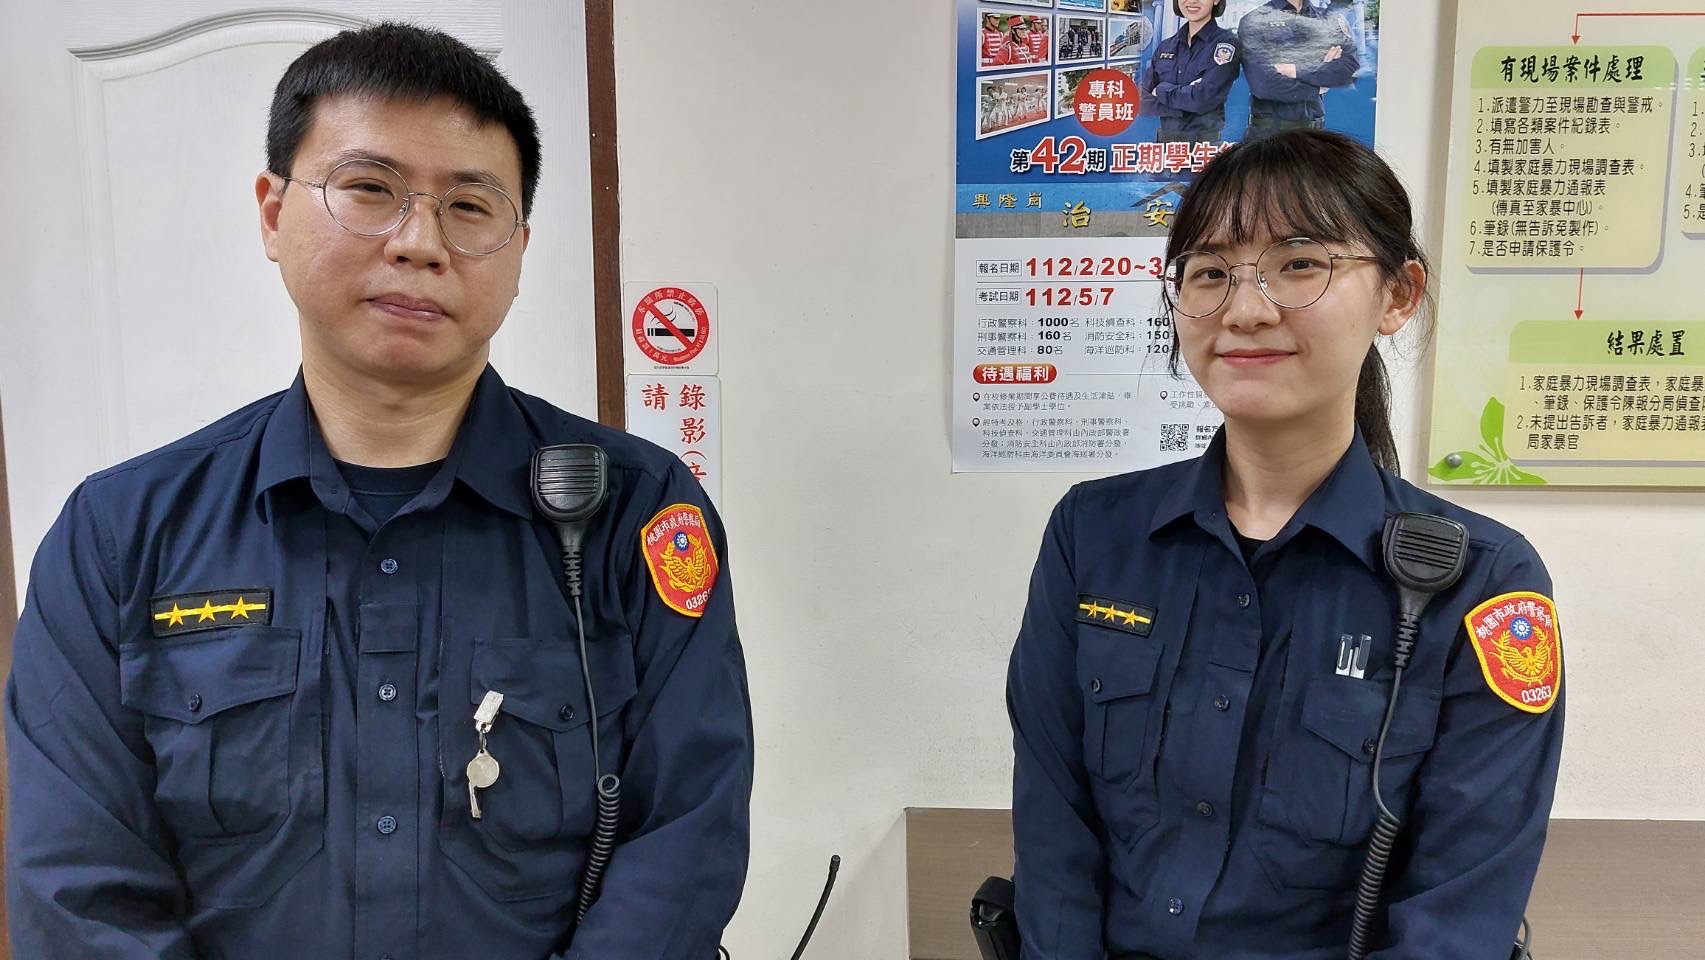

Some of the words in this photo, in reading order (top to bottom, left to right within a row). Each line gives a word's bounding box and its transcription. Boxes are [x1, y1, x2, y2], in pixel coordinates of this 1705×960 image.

[1499, 54, 1645, 84] 有現場案件處理
[1087, 79, 1125, 99] 專科
[1078, 102, 1134, 122] 警員班
[1010, 136, 1106, 175] 第42期
[1109, 140, 1237, 174] 正期學生
[978, 262, 1020, 275] 報名日期
[977, 290, 1020, 303] 考試日期
[1025, 287, 1115, 307] 112/5/7
[1084, 331, 1173, 341] 消防安全科：150
[1606, 329, 1686, 357] 結果處置
[1084, 344, 1172, 355] 海洋巡防科：120
[982, 366, 1050, 383] 待遇福利
[641, 384, 670, 411] 請
[1527, 433, 1579, 450] 局家暴官
[1475, 600, 1553, 639] 桃園市政府警察局
[1521, 685, 1552, 703] 03263
